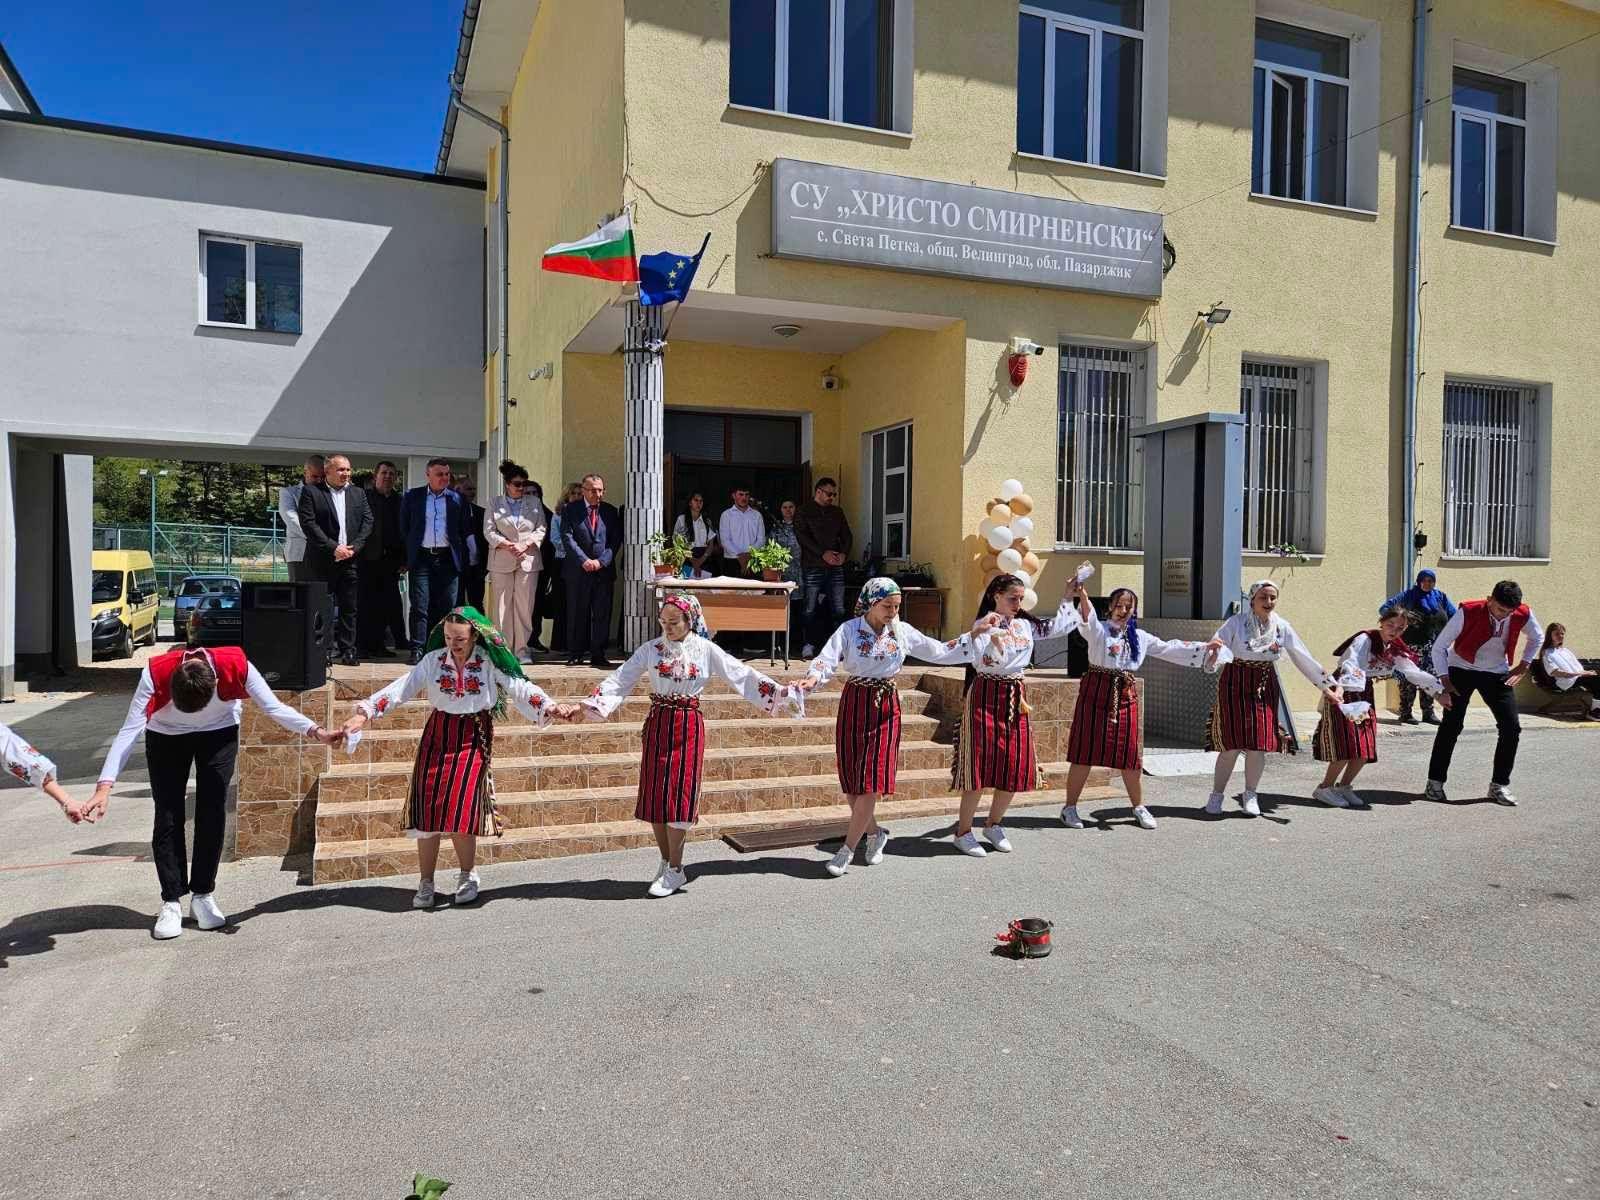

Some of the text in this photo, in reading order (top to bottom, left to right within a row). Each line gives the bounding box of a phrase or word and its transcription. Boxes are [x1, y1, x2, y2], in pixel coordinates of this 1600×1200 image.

[790, 181, 1153, 251] СУ „ХРИСТО СМИРНЕНСКИ“
[817, 228, 1132, 279] с. Света Петка, общ. Велинград, обл. Пазарджик
